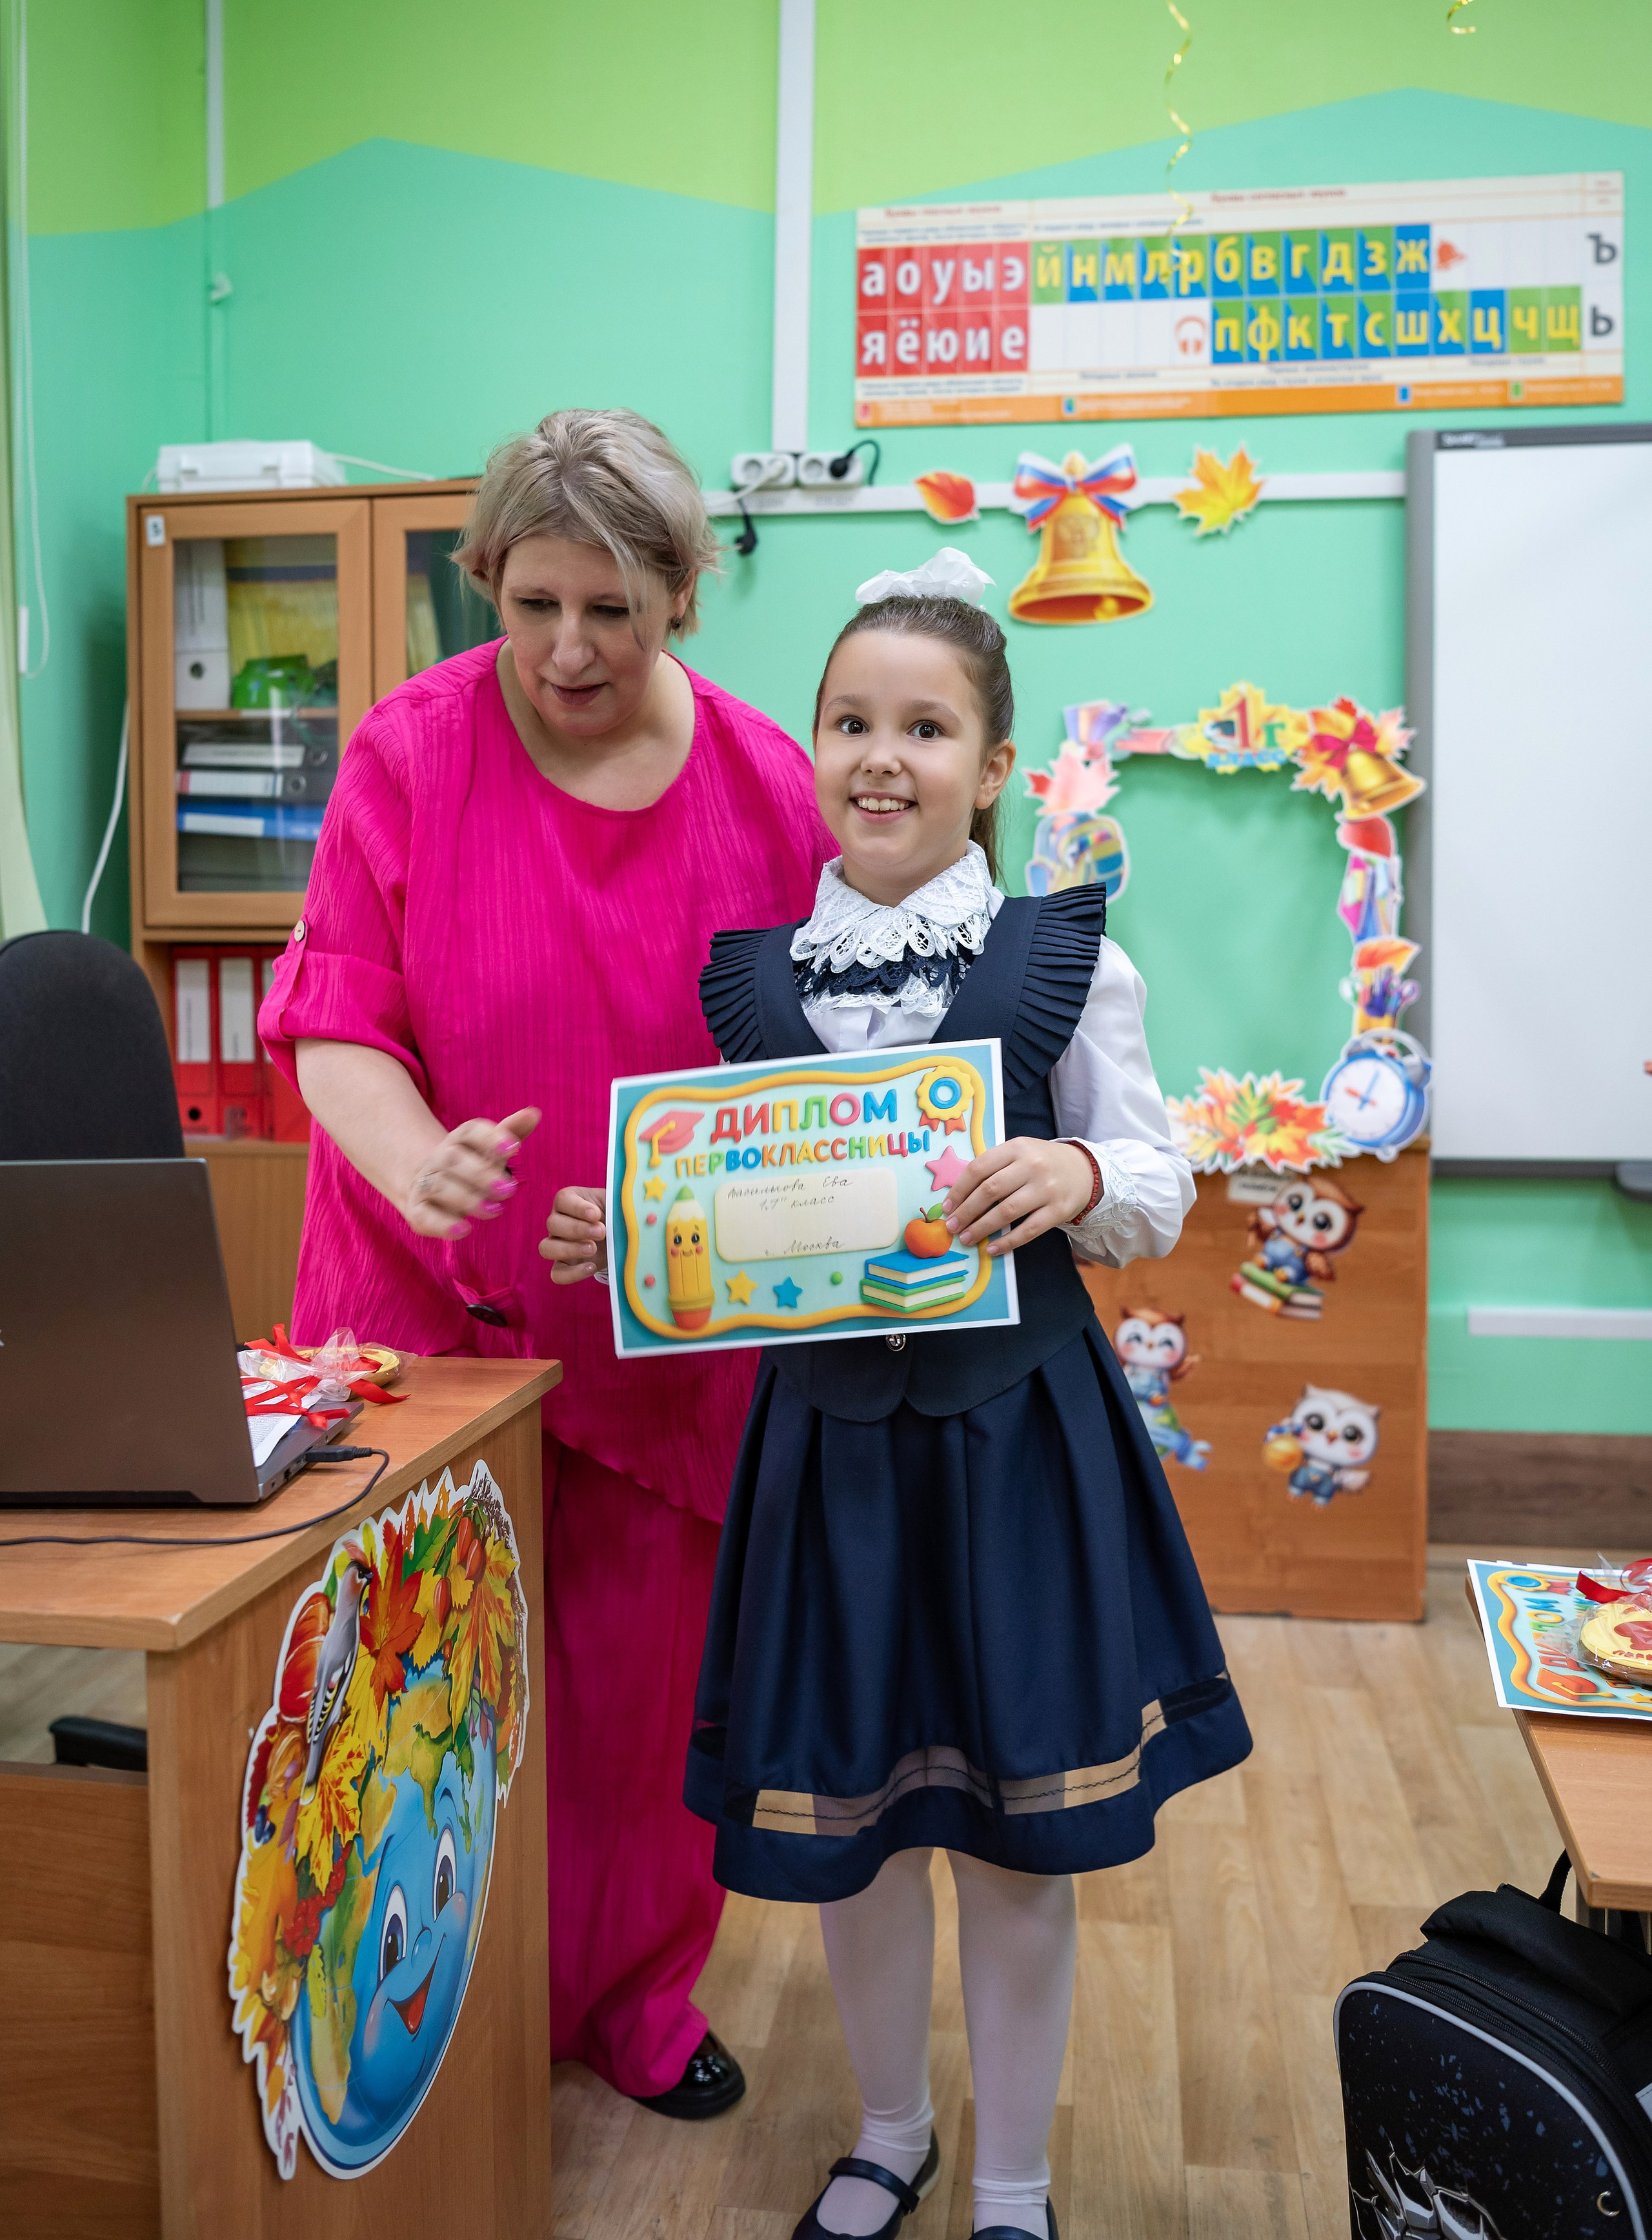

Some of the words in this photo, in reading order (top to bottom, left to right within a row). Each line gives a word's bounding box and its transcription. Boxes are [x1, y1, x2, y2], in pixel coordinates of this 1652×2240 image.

[710, 1088, 898, 1144] ДИПЛОМ
[675, 1129, 931, 1177] ПЕРВОКЛАССНИЦЫ
[821, 1175, 853, 1188] Ева
[791, 1195, 835, 1209] класс
[783, 1235, 845, 1255] Москва
